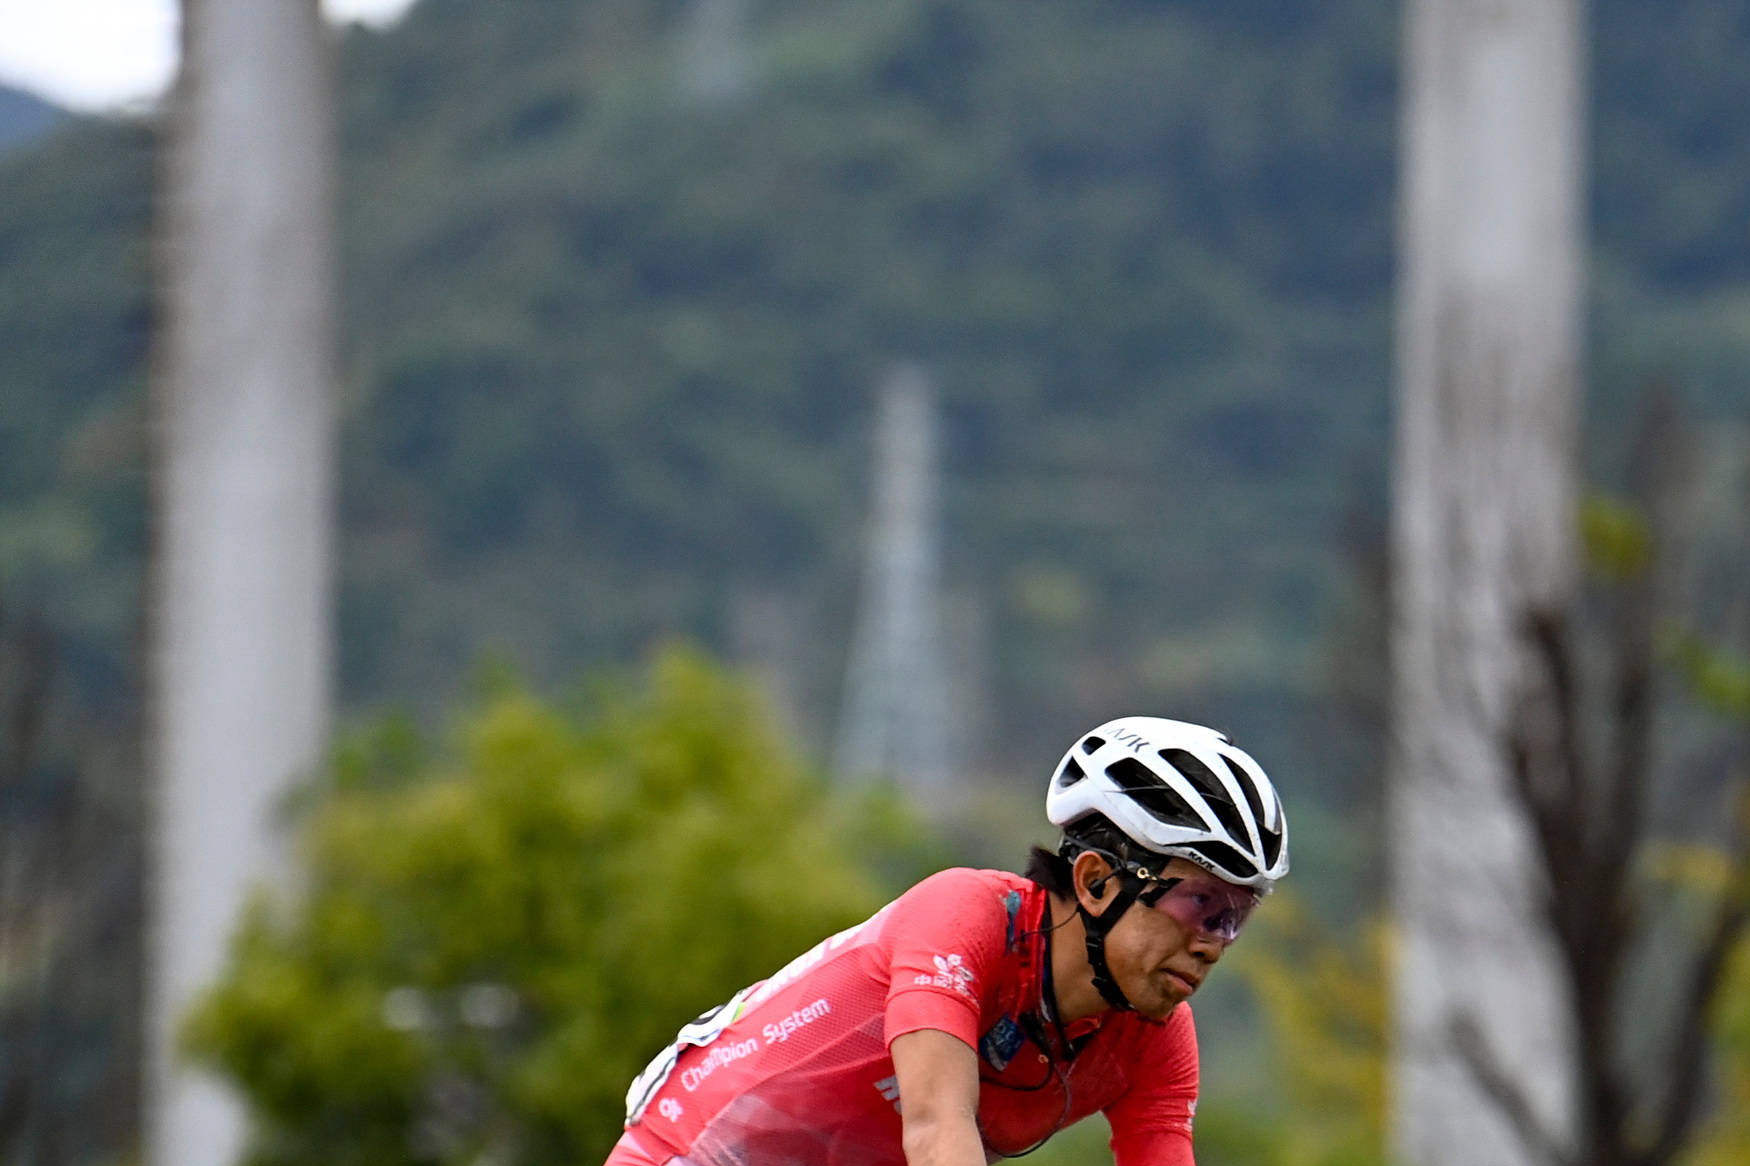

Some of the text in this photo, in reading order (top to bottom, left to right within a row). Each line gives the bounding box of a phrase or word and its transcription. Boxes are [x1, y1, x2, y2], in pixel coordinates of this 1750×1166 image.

[1188, 850, 1216, 872] KASK
[680, 997, 832, 1092] Champion System
